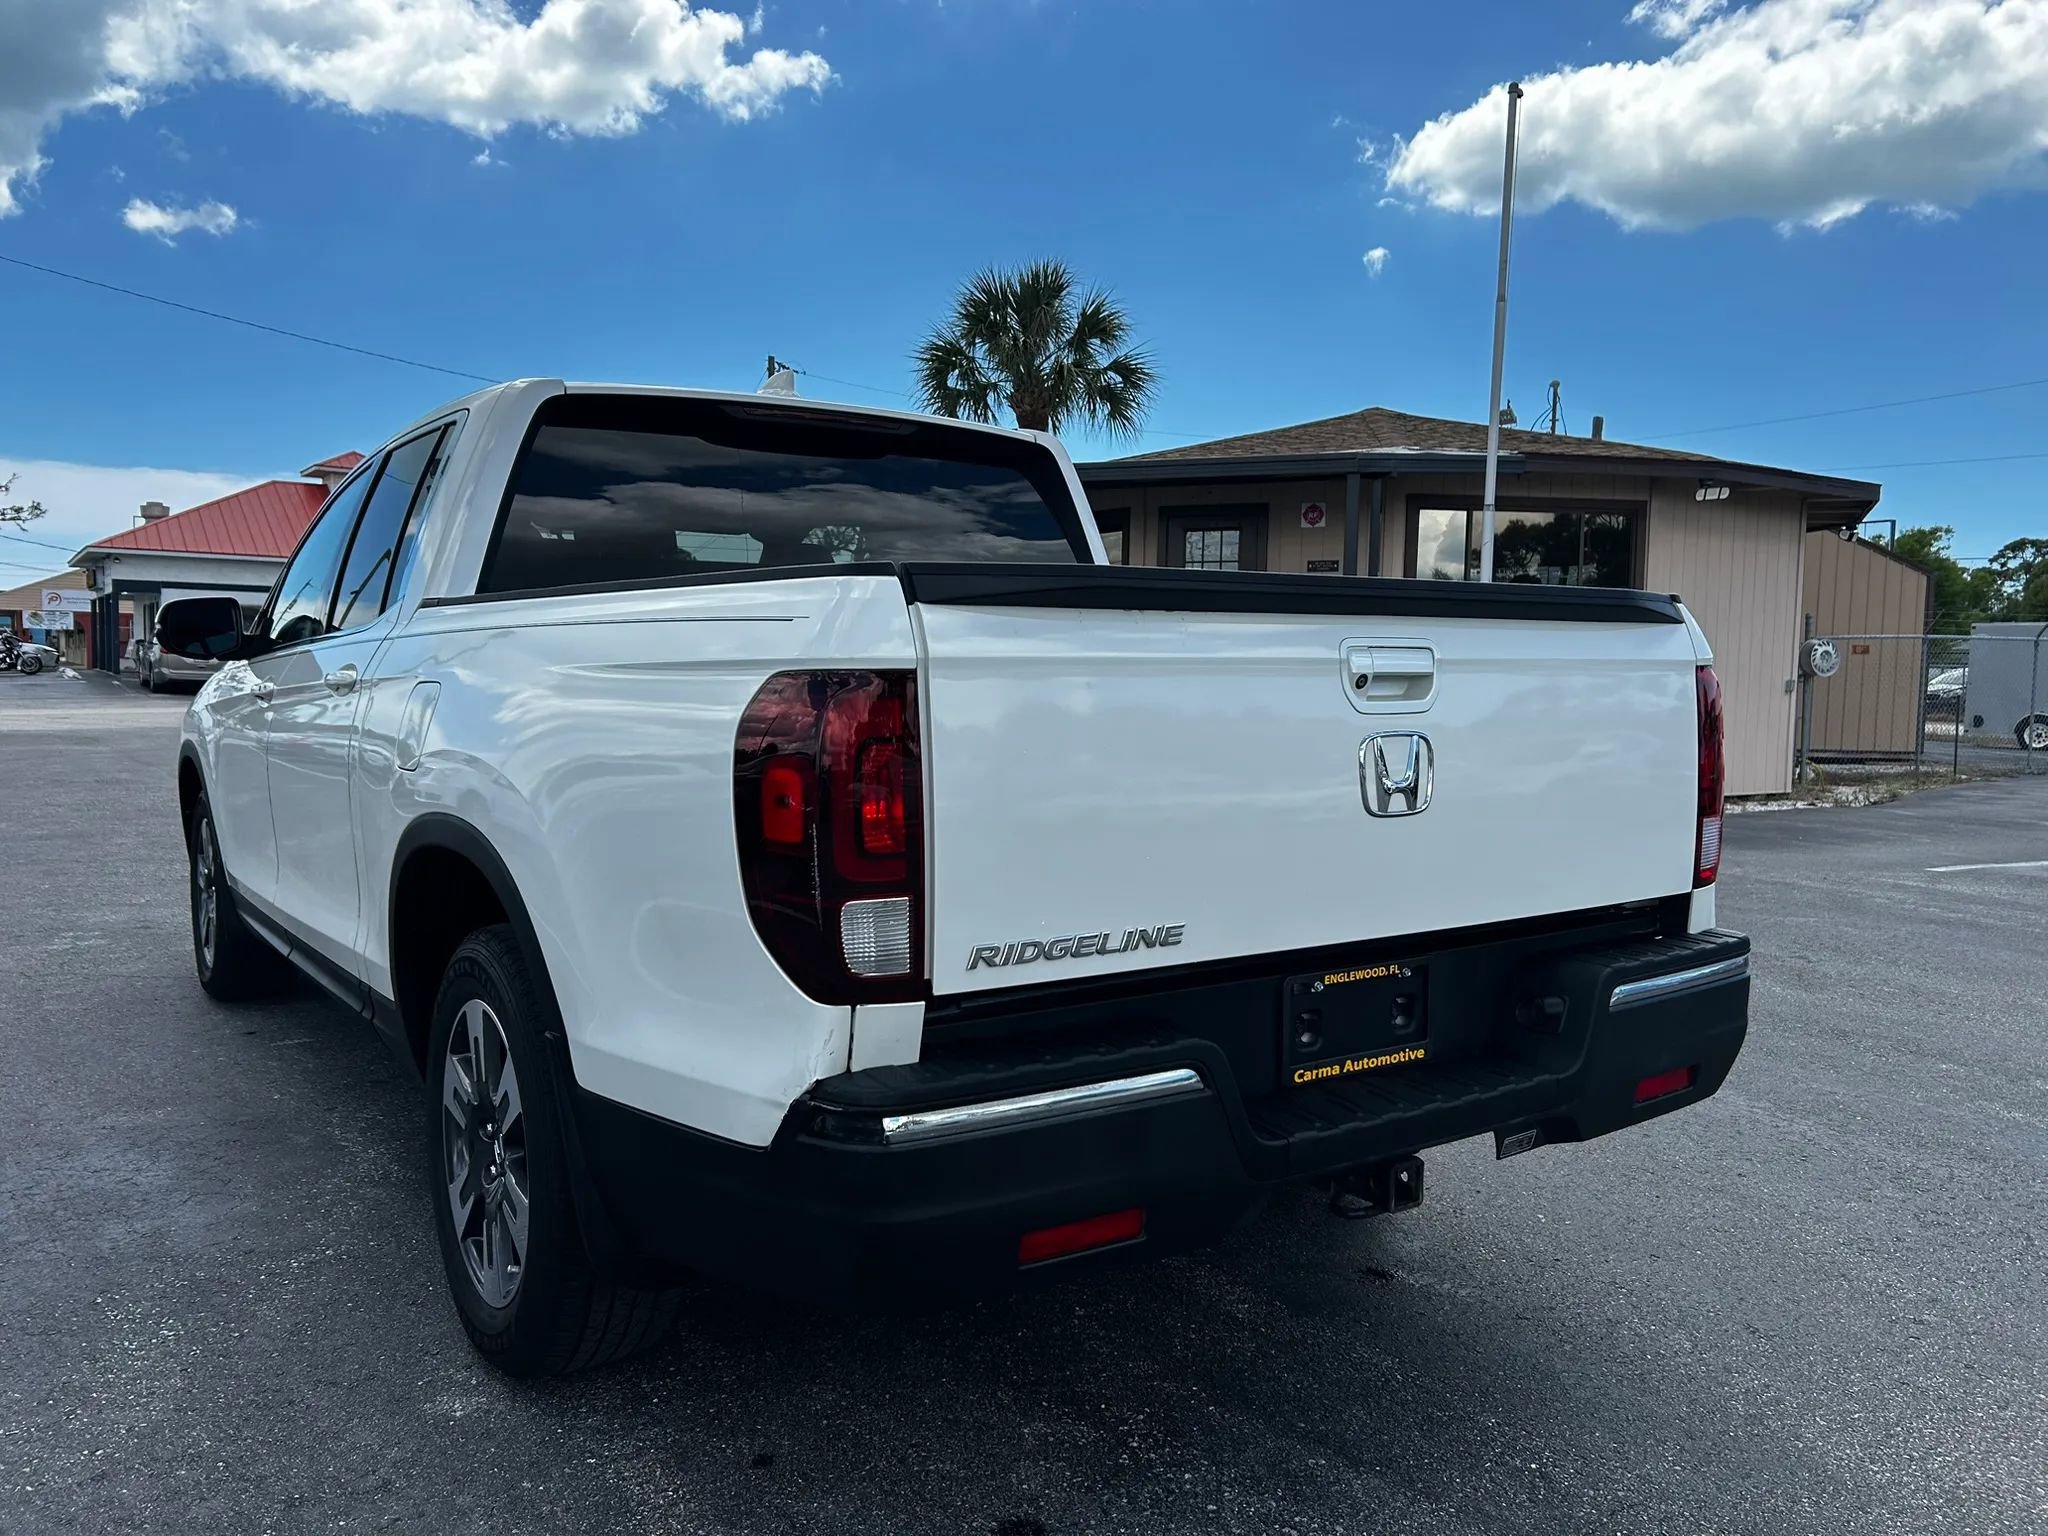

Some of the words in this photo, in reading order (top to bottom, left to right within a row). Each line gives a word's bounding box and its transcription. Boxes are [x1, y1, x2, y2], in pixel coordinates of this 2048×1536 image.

[966, 922, 1186, 971] RIDGELINE
[1324, 966, 1388, 985] ENGLEWOOD,
[1389, 964, 1400, 975] FL
[1294, 1065, 1340, 1083] Carma
[1343, 1048, 1425, 1073] Automotive
